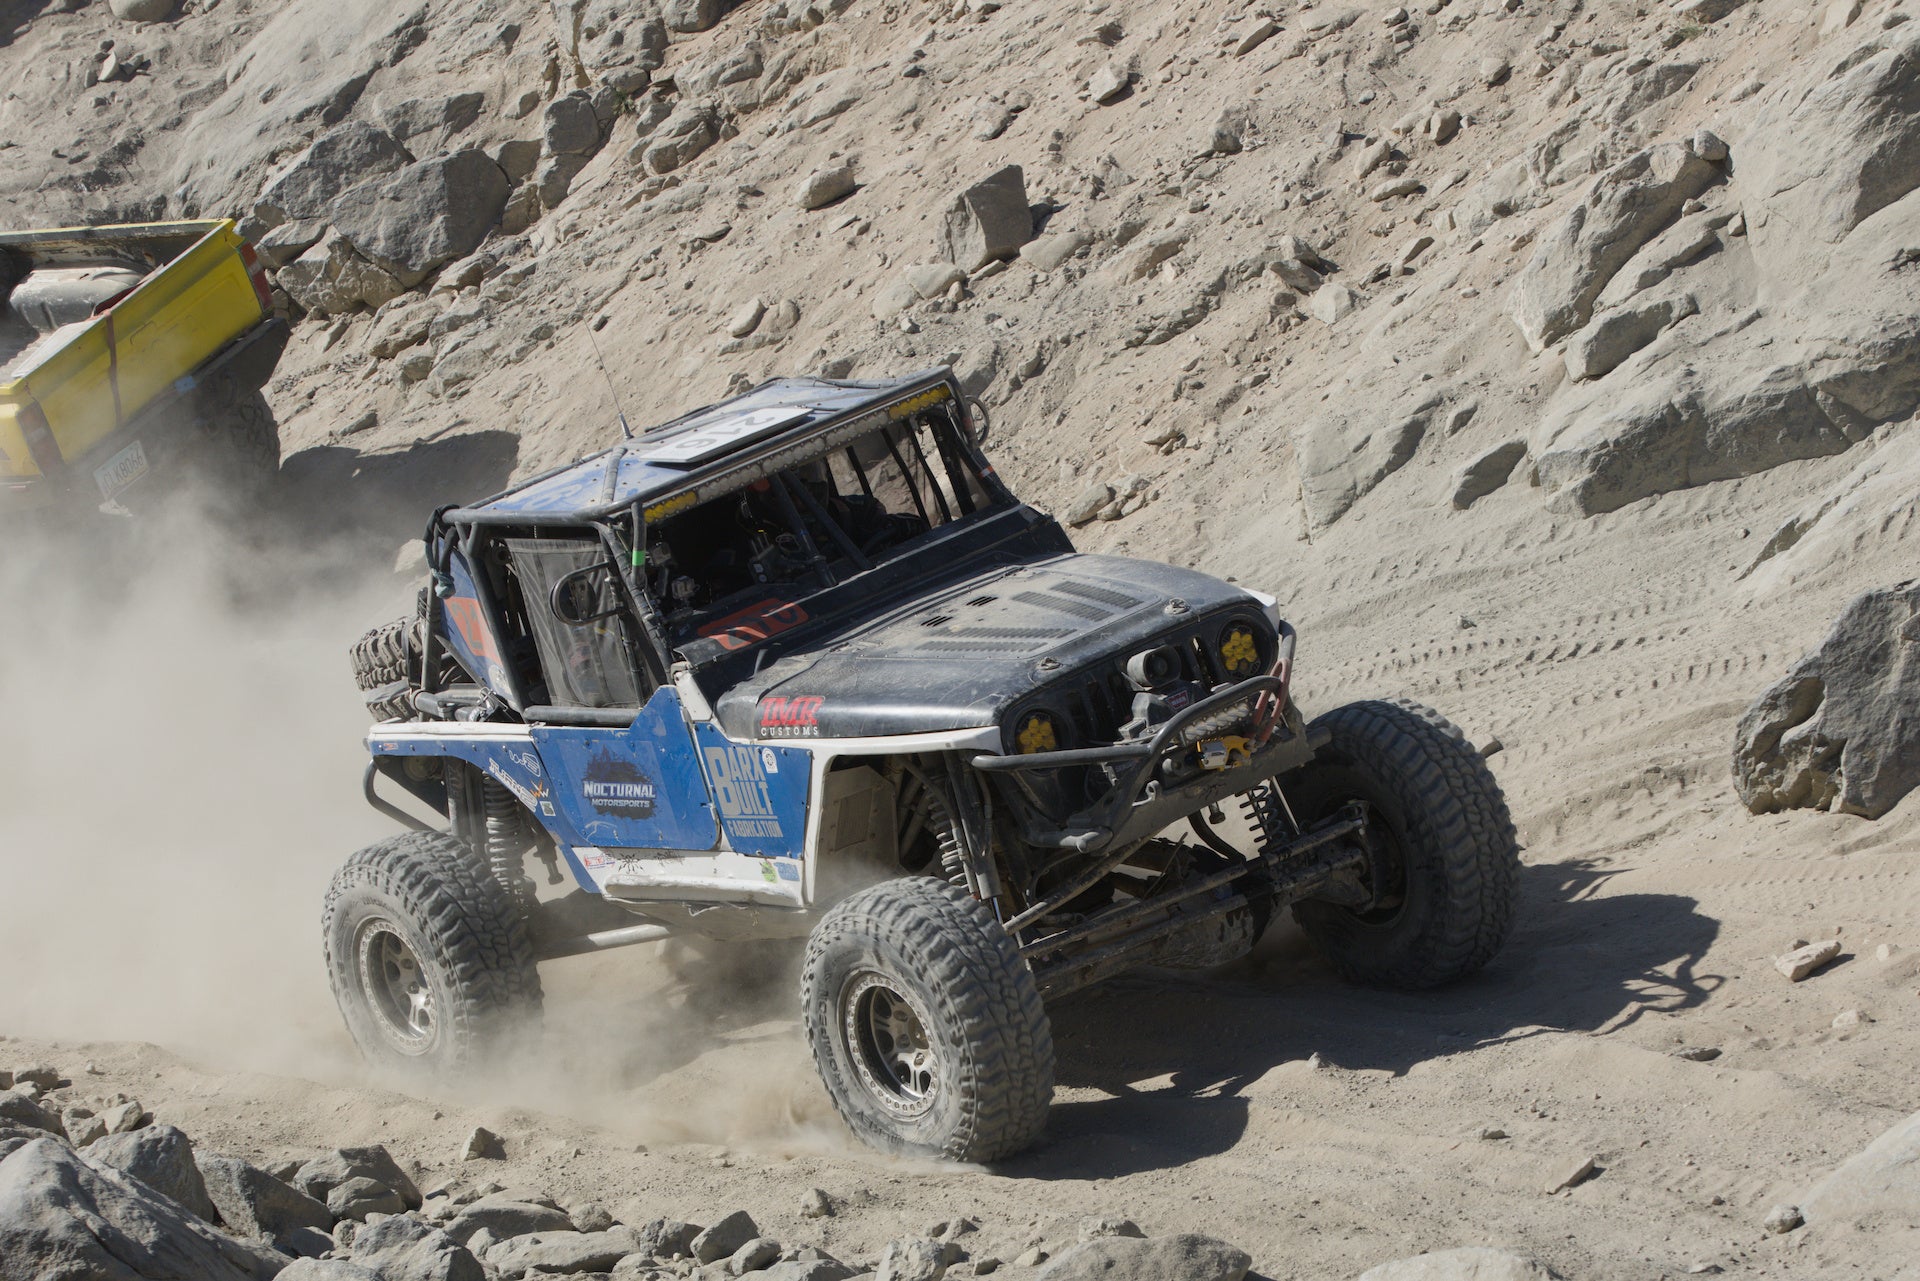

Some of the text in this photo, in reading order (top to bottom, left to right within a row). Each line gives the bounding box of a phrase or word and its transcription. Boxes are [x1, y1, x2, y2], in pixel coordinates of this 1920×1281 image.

[675, 416, 775, 449] 216
[760, 726, 819, 737] CUSTOMS
[582, 781, 656, 798] NOCTURNAL
[591, 798, 650, 808] MOTORSPORTS
[726, 820, 784, 838] FABRICATION
